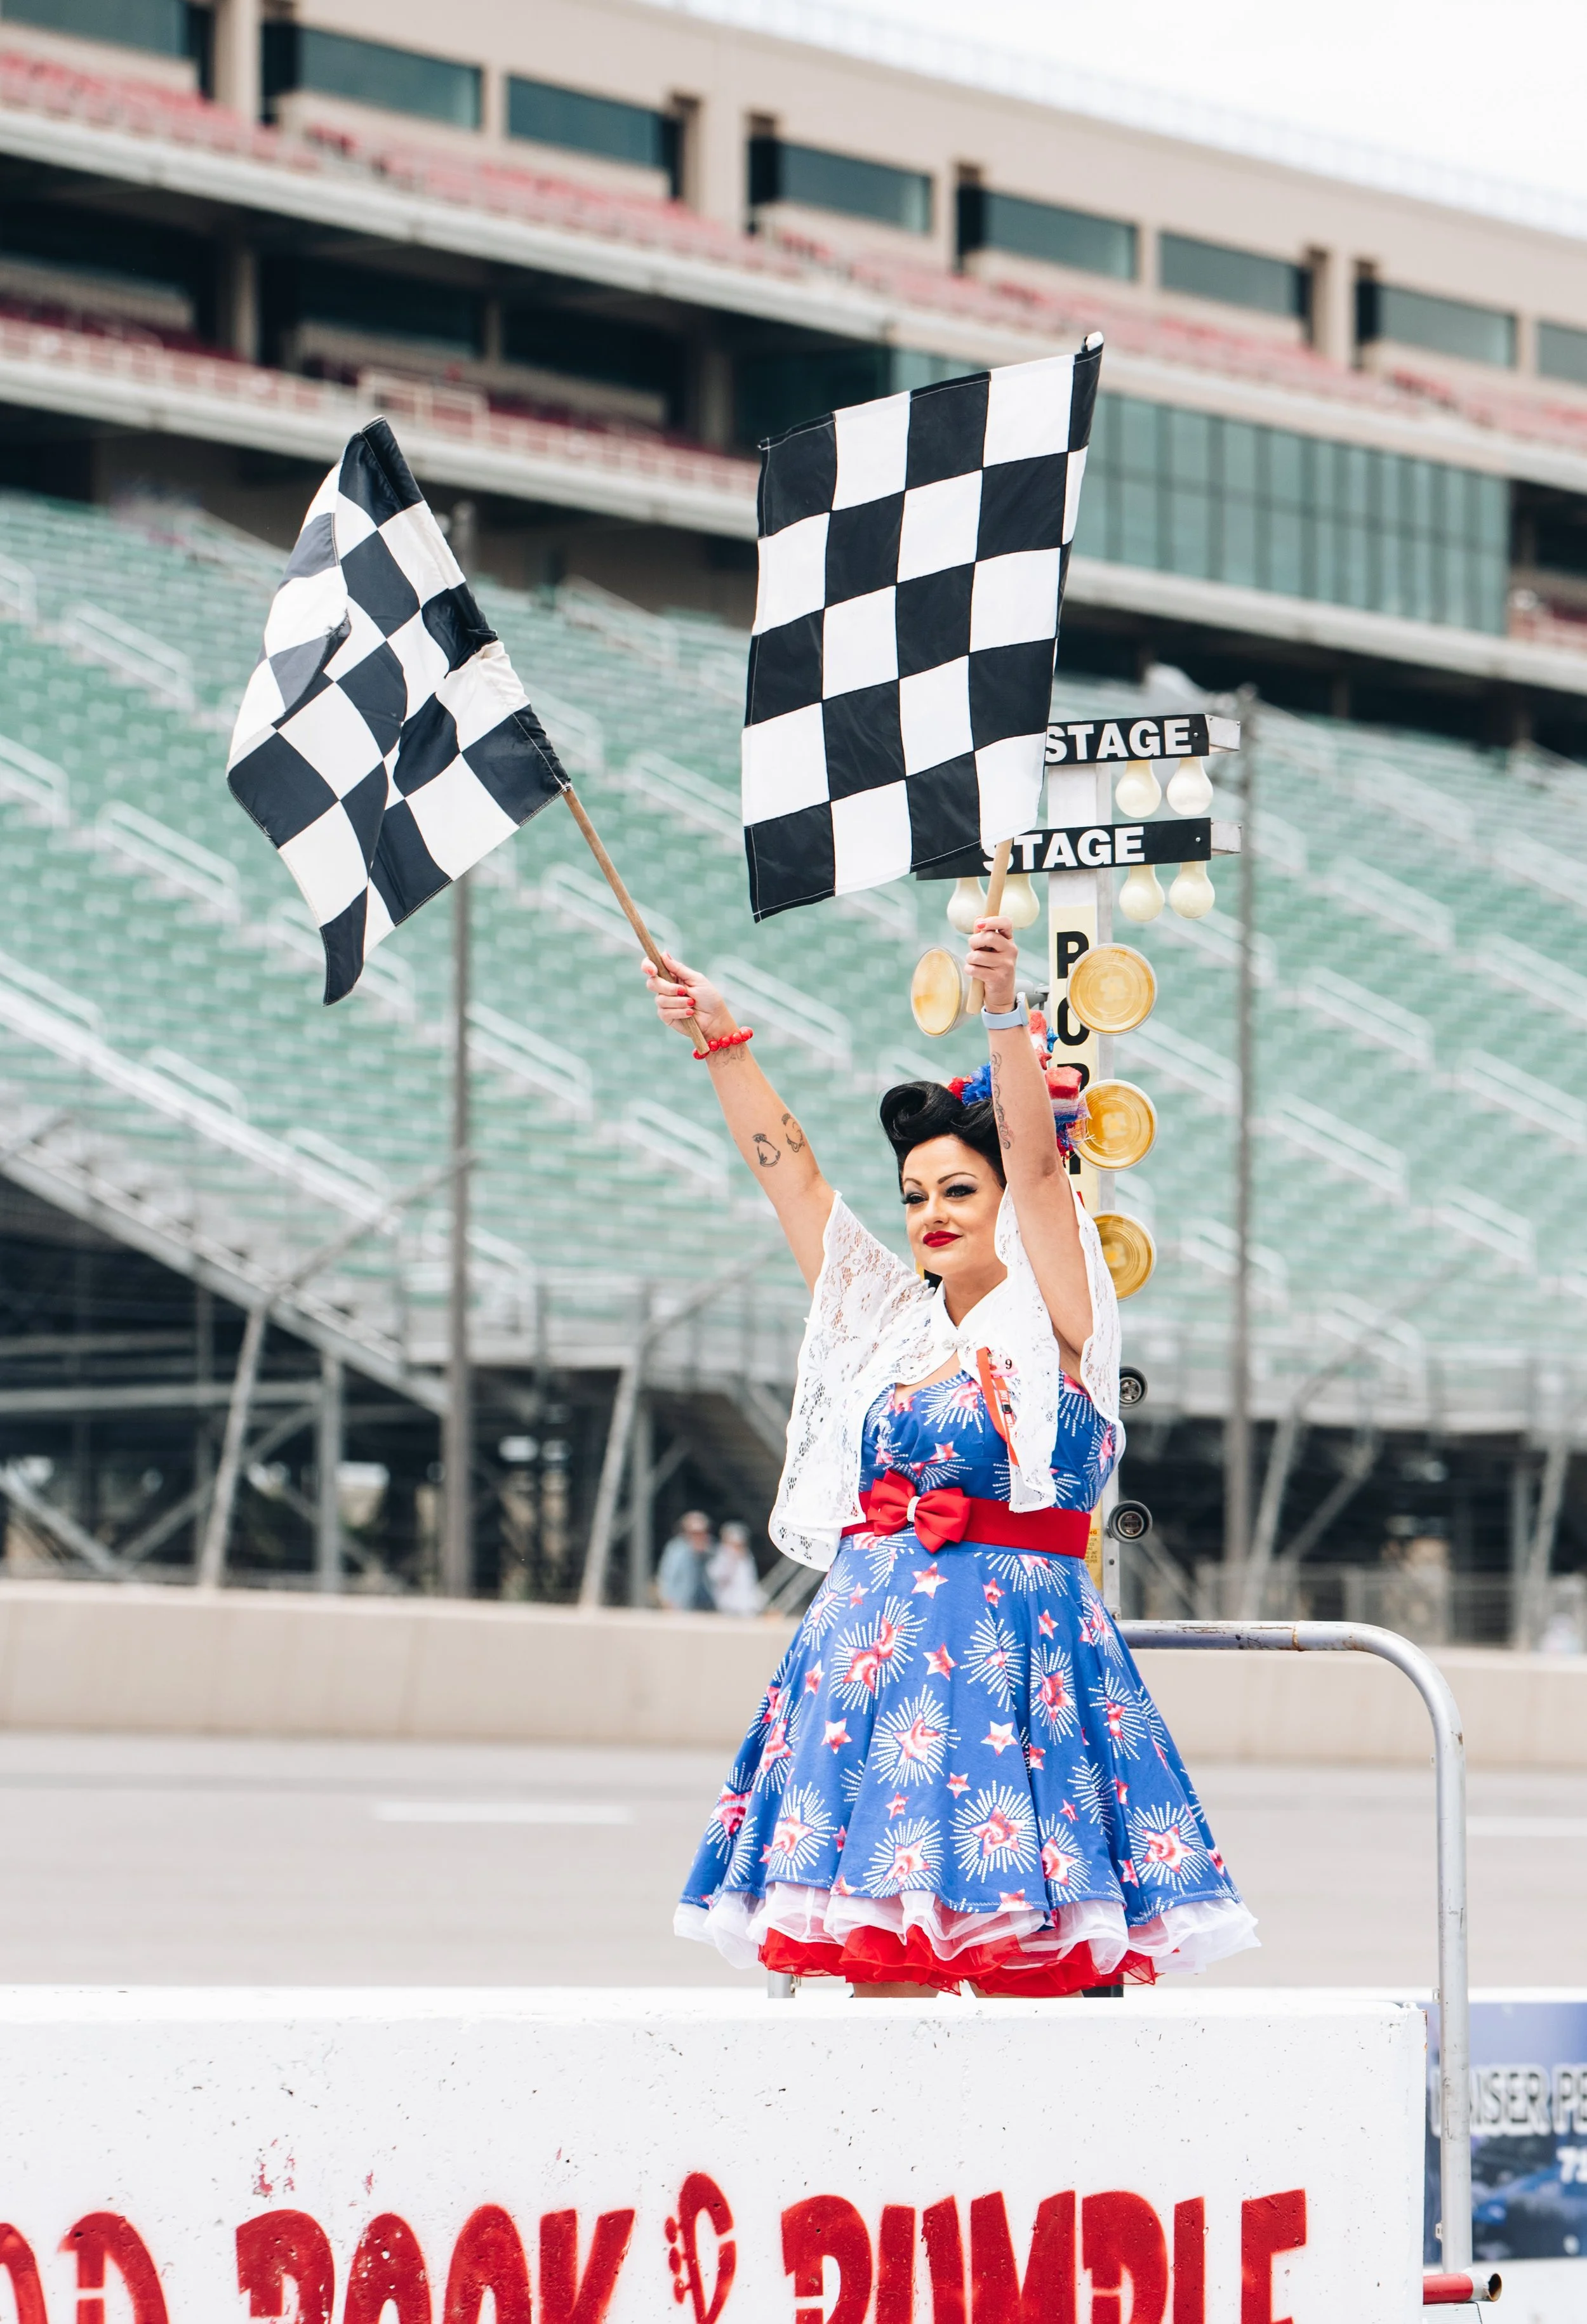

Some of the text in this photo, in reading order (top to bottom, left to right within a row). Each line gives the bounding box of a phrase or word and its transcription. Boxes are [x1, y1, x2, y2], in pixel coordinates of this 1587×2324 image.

[1045, 718, 1192, 763] STAGE
[1056, 930, 1090, 1175] PO
[1005, 1359, 1013, 1370] 9
[1430, 2064, 1551, 2136] ISER
